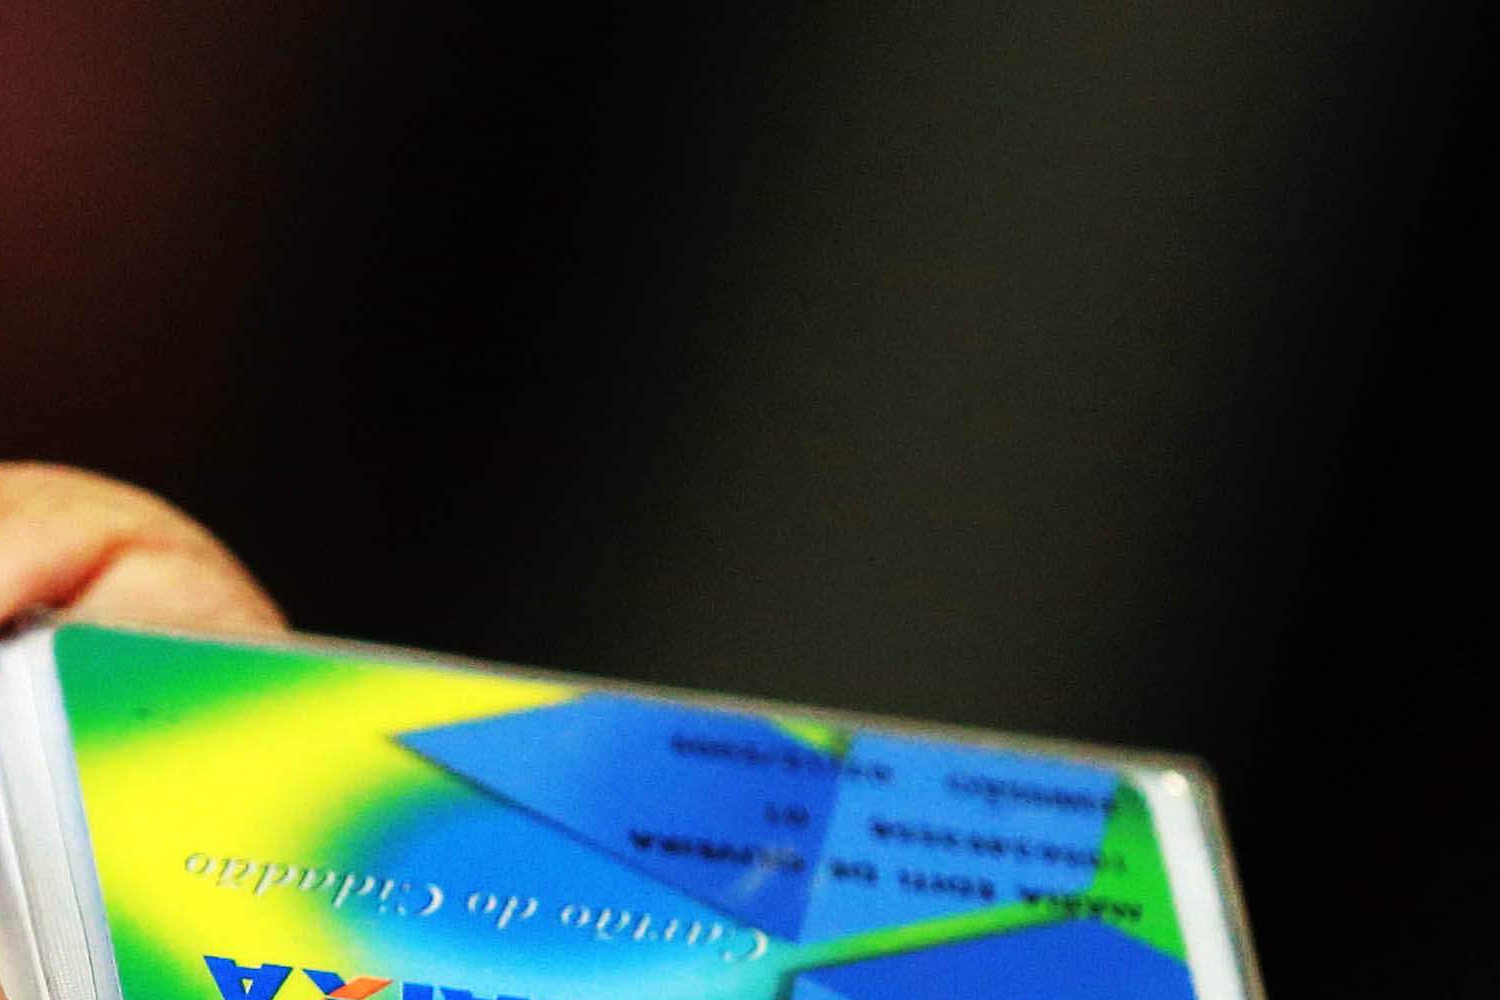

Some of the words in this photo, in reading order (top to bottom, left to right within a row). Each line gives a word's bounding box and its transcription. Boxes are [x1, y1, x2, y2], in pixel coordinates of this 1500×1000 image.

[183, 851, 445, 917] Cidadão
[466, 894, 539, 930] do
[560, 903, 768, 962] Cartão
